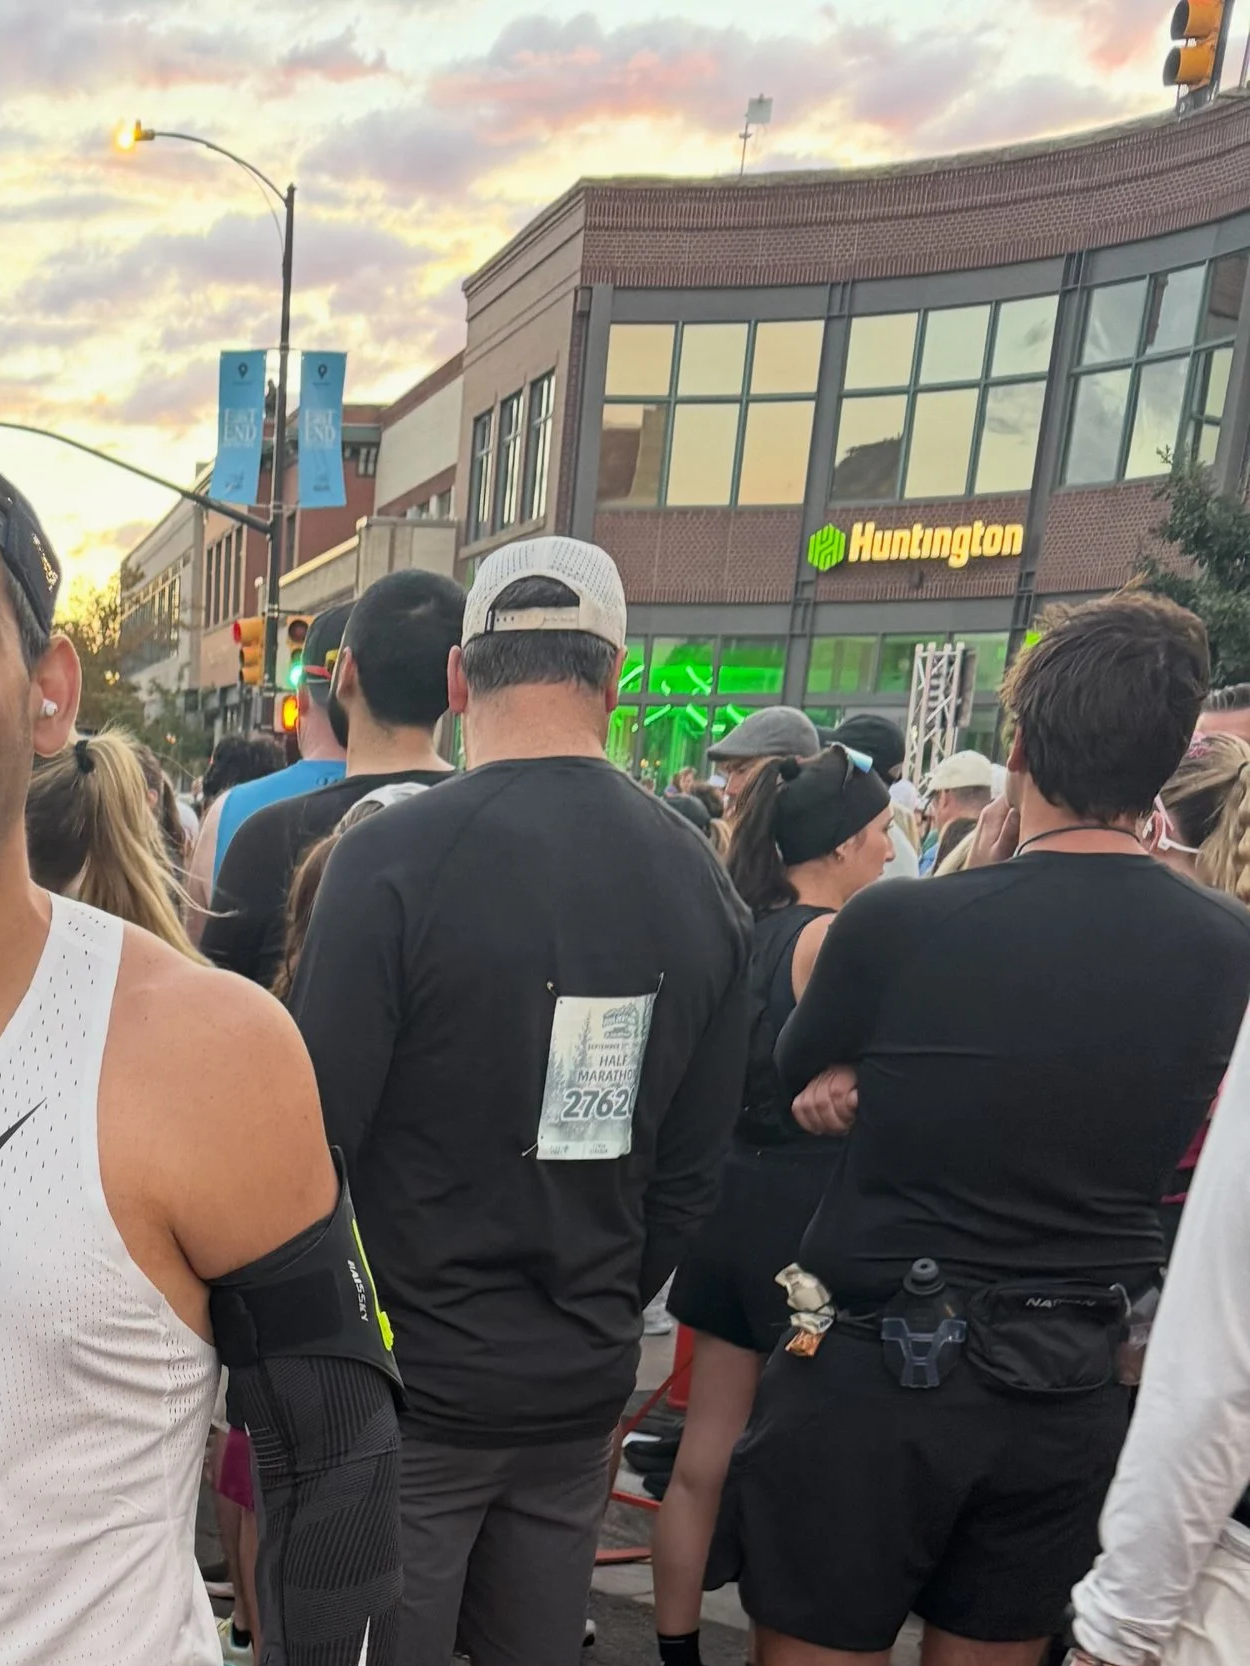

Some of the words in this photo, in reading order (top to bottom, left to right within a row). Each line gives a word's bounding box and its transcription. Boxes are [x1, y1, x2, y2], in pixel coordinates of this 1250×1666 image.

[223, 424, 257, 442] END
[305, 425, 337, 444] END
[848, 520, 1024, 568] Huntington
[600, 1055, 627, 1067] HALF
